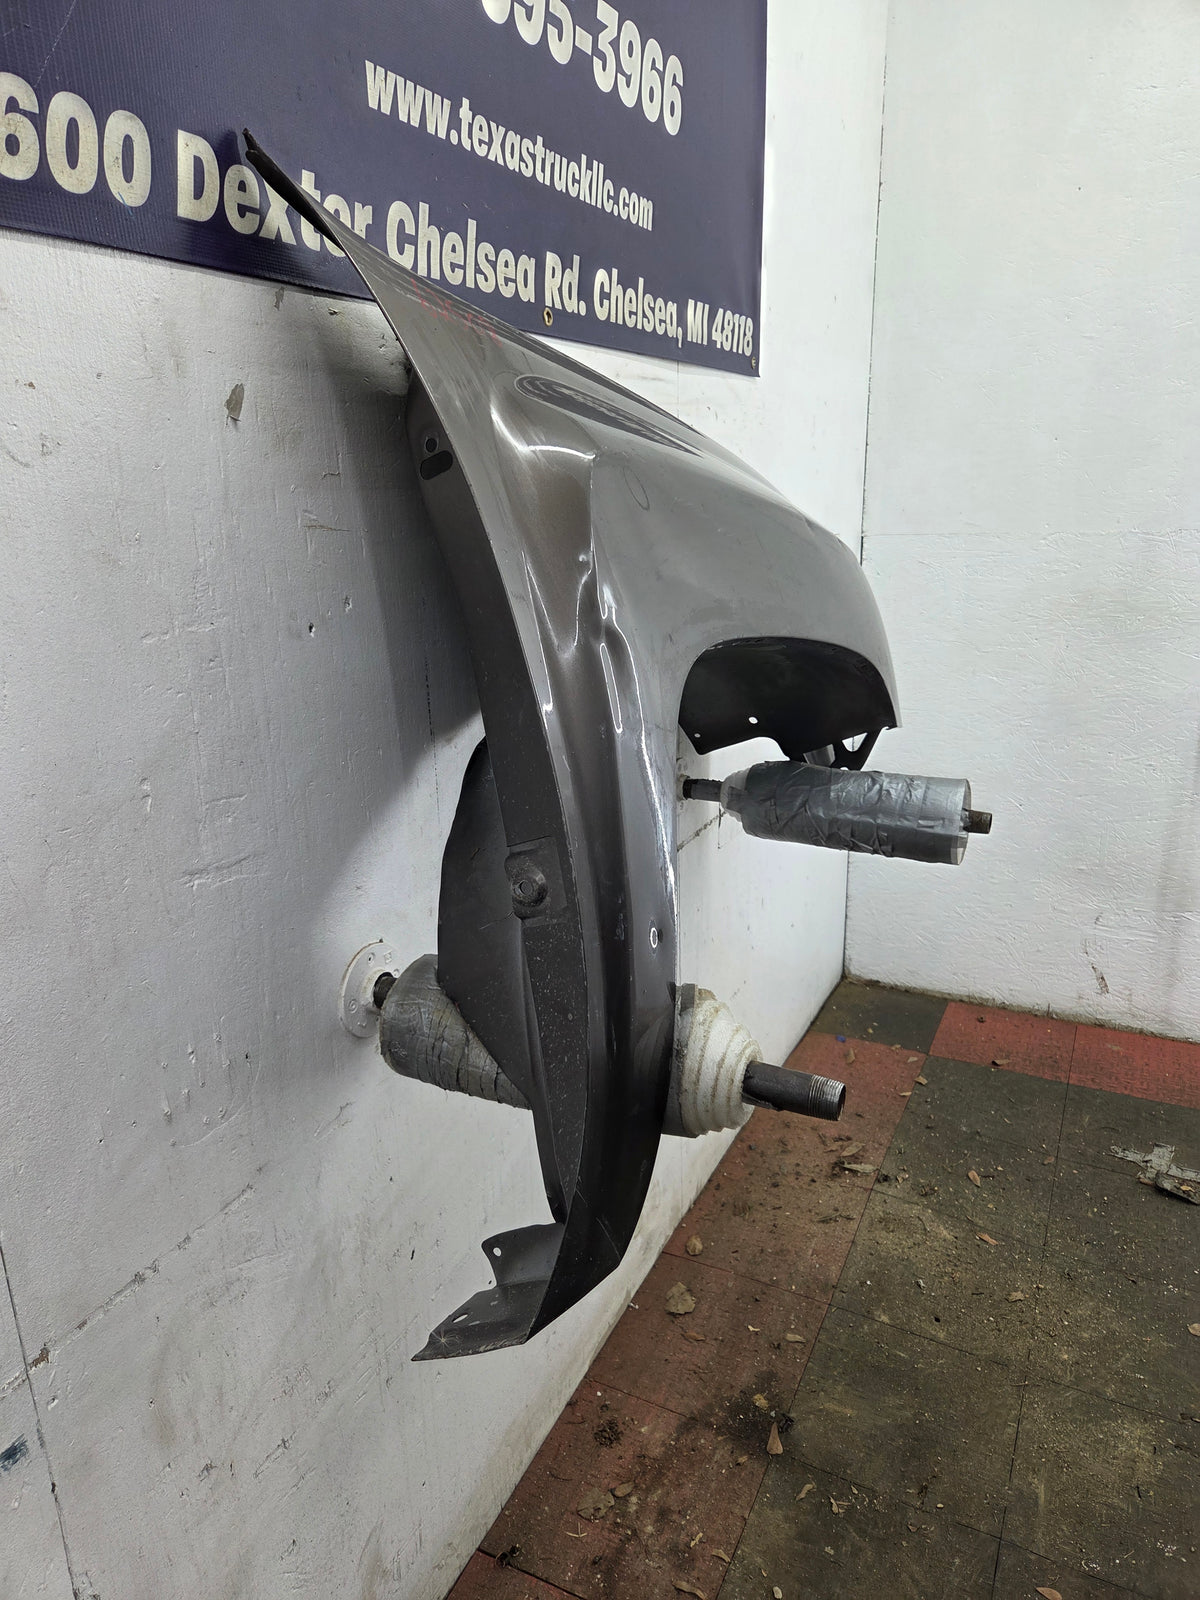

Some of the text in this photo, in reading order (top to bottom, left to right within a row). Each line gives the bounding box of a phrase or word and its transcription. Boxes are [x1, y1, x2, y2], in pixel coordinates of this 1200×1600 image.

[0, 71, 151, 207] 600
[386, 200, 536, 303] Chelsea
[545, 251, 587, 316] Rd.
[594, 268, 682, 348] Chelsea,
[687, 299, 709, 346] MI
[712, 308, 753, 357] 48118
[365, 60, 653, 231] www.texastruckllc.com
